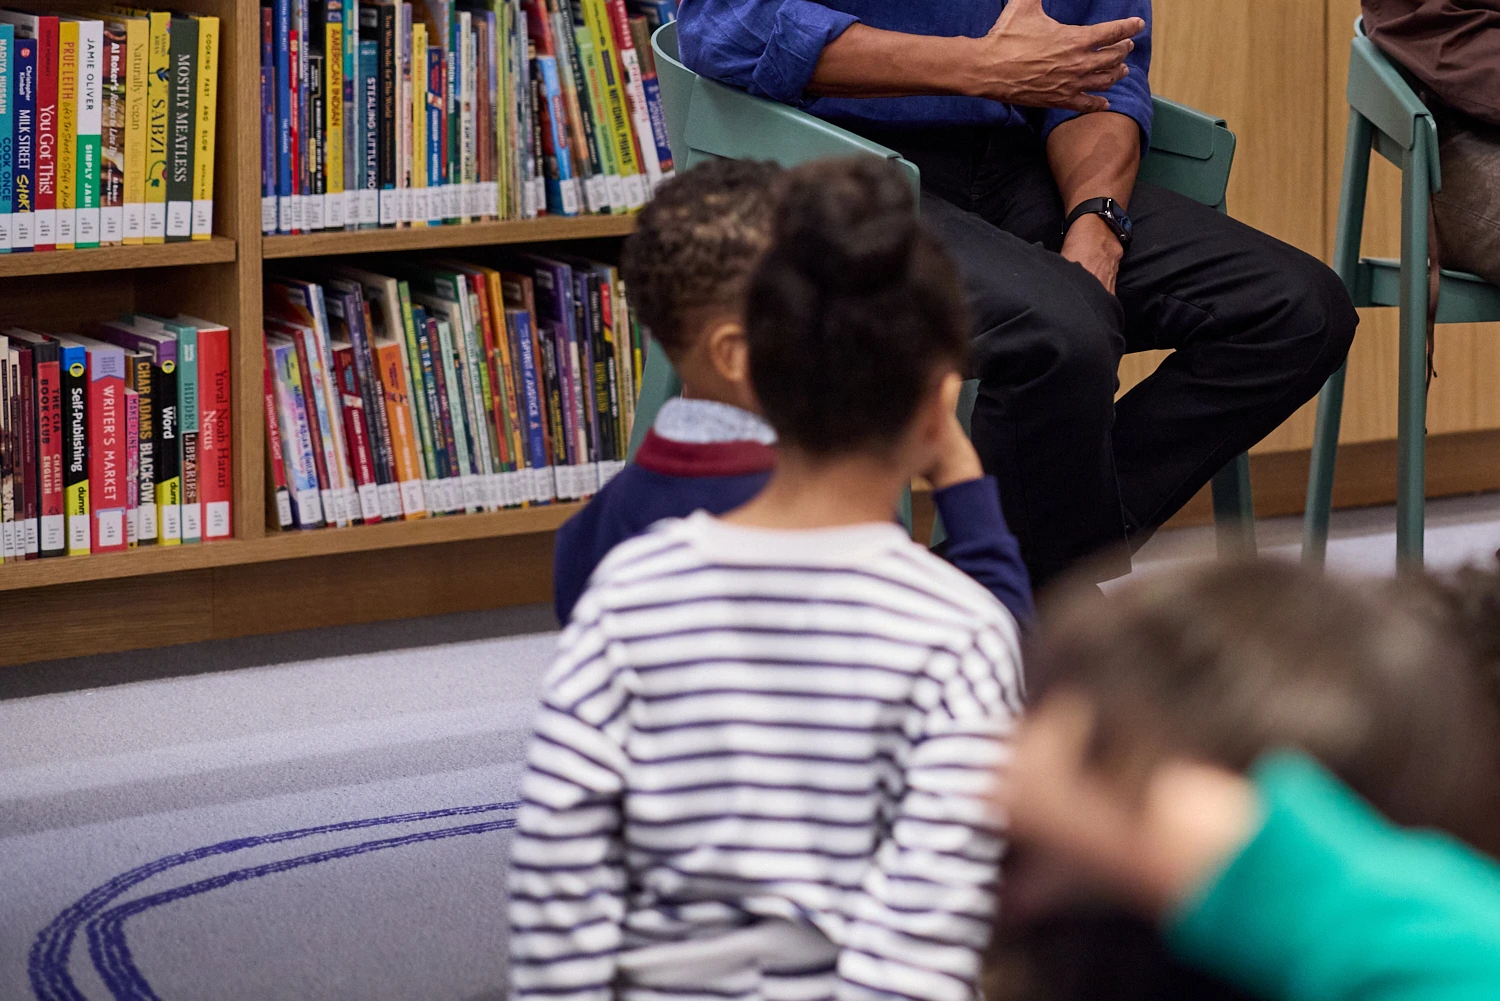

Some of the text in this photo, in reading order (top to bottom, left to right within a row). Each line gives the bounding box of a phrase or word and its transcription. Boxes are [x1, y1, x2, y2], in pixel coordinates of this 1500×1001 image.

[24, 65, 32, 101] Christopher
[63, 41, 74, 99] PRUE LEITH
[110, 56, 120, 91] Roker's
[130, 43, 144, 131] Naturally Vegan
[203, 33, 212, 97] COOKING FAST
[331, 28, 341, 126] AMERICAN INDIAN
[18, 109, 31, 134] MILK
[84, 38, 95, 180] JAMIE OLIVER SIMPLY
[150, 98, 166, 154] SABZI
[174, 53, 191, 182] MOSTLY MEATLESS
[367, 76, 377, 166] STEALING LITTLE
[2, 136, 11, 201] COOK ONCE
[18, 135, 31, 169] STREET
[39, 104, 55, 195] You Got This!
[52, 387, 60, 433] THE CIA
[138, 361, 152, 439] CHAR ADAMS
[520, 339, 540, 417] SPIRIT JUSTICE
[40, 378, 50, 444] BOOK CLUB
[70, 387, 85, 472] Self-Publishing
[103, 384, 117, 500] WRITER'S MARKET
[162, 405, 175, 439] Word
[183, 381, 197, 498] HIDDEN LIBRARIES
[202, 409, 217, 451] Nexus
[215, 369, 229, 488] Yuval Noah Harari
[265, 394, 277, 430] SHINING
[43, 455, 52, 494] ENGLISH
[53, 453, 62, 493] CHARLIE
[270, 436, 282, 460] LIGHT
